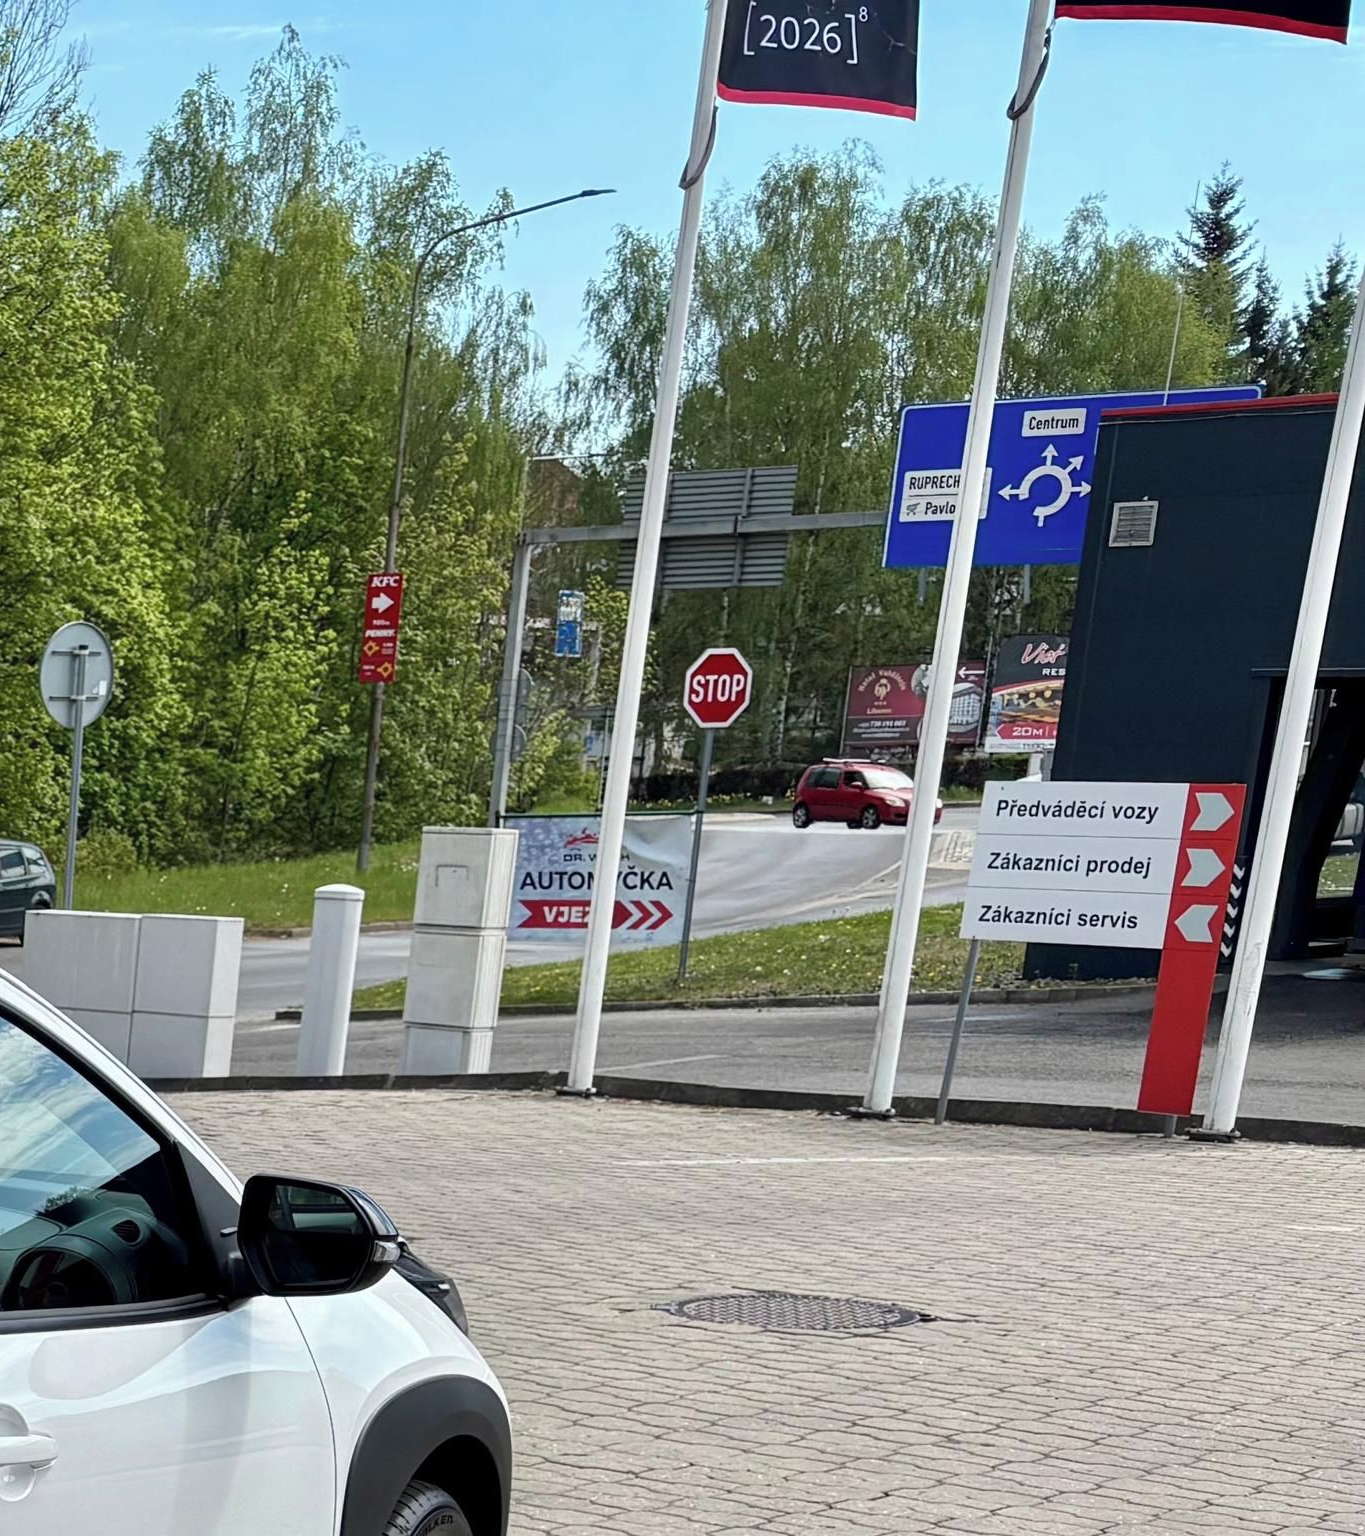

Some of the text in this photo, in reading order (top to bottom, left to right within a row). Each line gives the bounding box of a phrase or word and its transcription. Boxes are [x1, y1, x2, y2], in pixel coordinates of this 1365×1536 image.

[1028, 416, 1080, 431] Centrum
[908, 474, 961, 490] RUPRECH
[924, 501, 956, 515] Pavlo
[371, 576, 400, 587] KFC
[1042, 668, 1066, 676] RES
[691, 674, 745, 703] STOP
[996, 799, 1159, 825] Předváděcí vozy
[563, 853, 586, 862] DR.
[987, 852, 1151, 879] Zákazníci prodej
[543, 906, 591, 923] VJEZ
[978, 905, 1138, 929] Zákazníci servis
